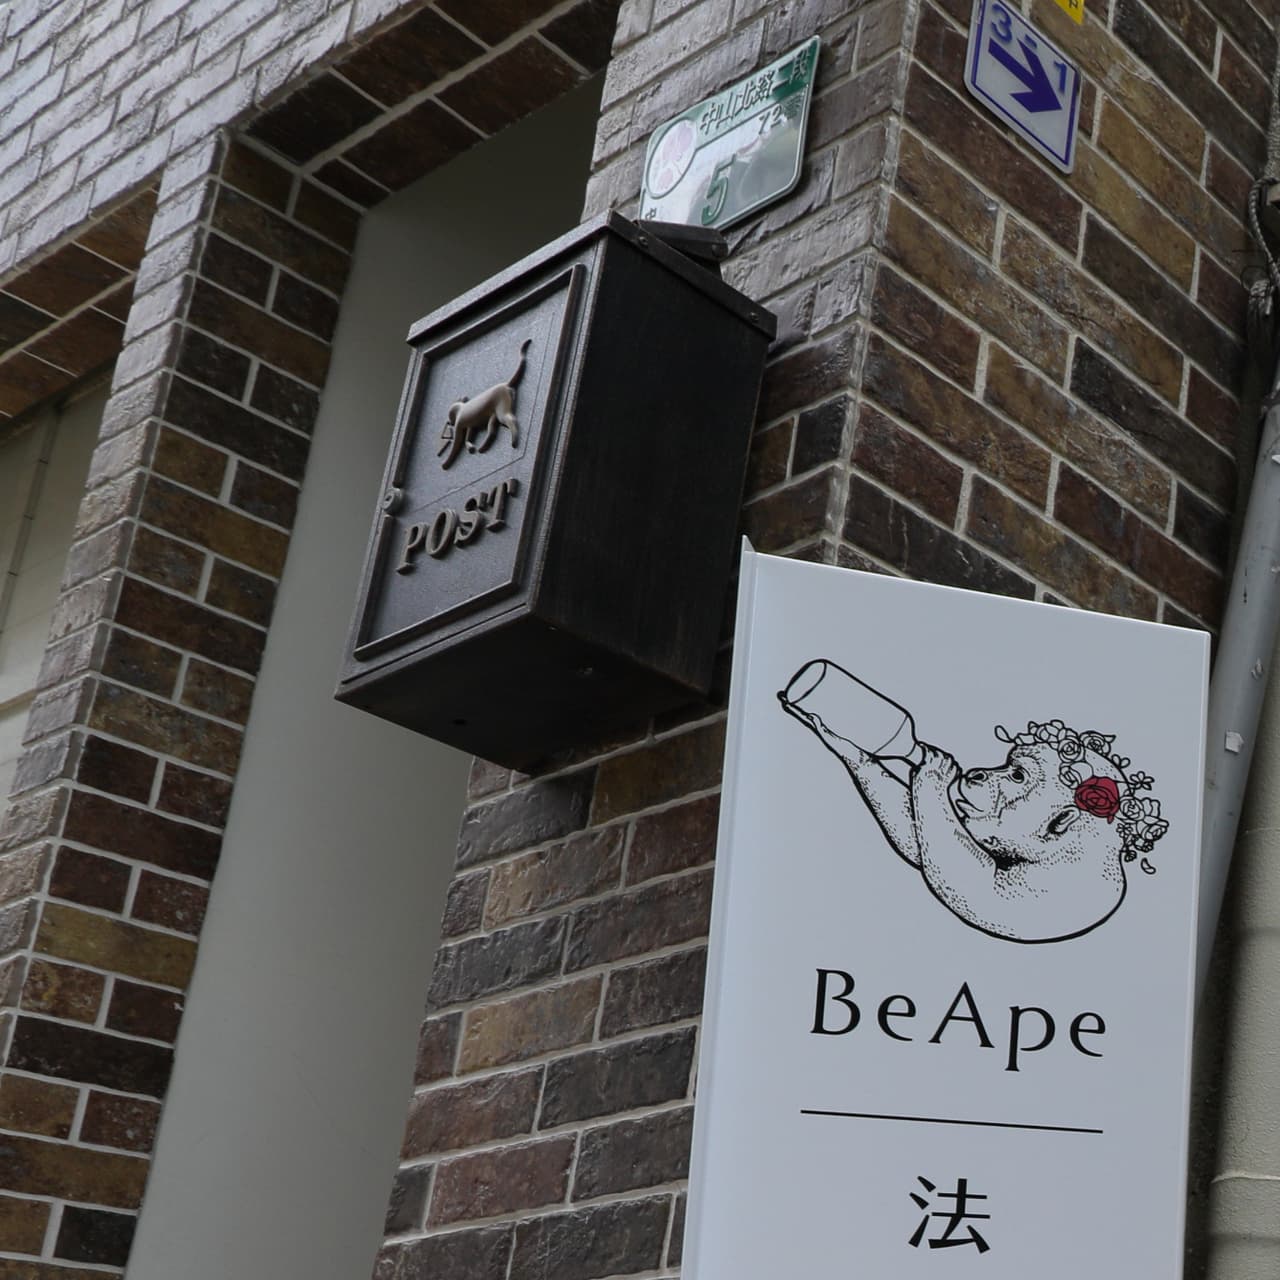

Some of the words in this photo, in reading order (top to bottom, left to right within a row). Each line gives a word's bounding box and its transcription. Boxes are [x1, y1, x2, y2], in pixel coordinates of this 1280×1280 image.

[699, 49, 811, 136] 中山北路二段
[701, 153, 736, 226] 5
[396, 477, 519, 575] POST
[809, 968, 1106, 1072] BeApe
